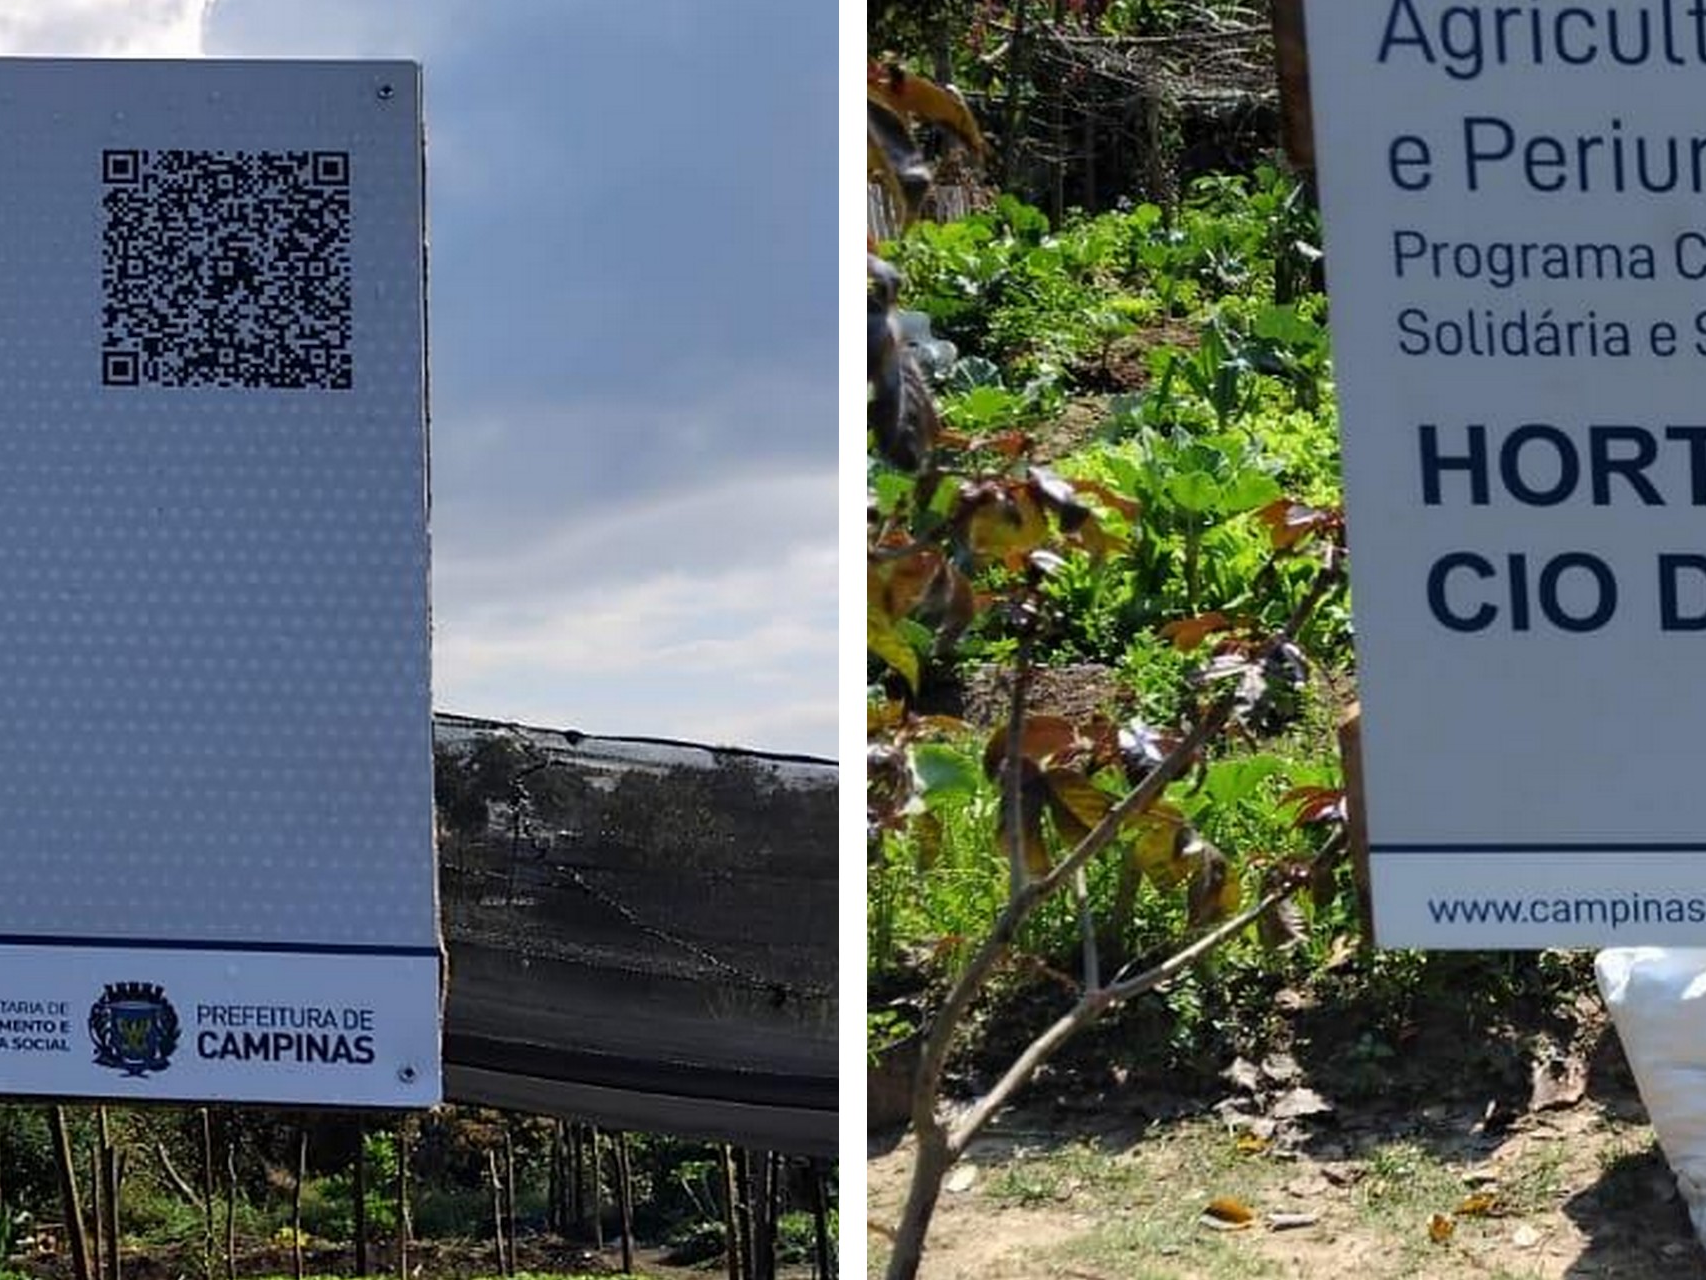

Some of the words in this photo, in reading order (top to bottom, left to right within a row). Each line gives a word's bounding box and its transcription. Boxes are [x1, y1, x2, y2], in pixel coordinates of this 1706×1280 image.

[1388, 135, 1432, 192] e
[1393, 230, 1656, 289] Programa
[1397, 308, 1631, 357] Solidária
[1649, 321, 1677, 357] e
[1426, 551, 1618, 633] CIO
[48, 1001, 69, 1015] DE
[197, 1005, 338, 1028] PREFEITURA
[344, 1010, 375, 1030] DE
[61, 1020, 70, 1033] E
[12, 1037, 70, 1051] SOCIAL
[197, 1031, 375, 1064] CAMPINAS
